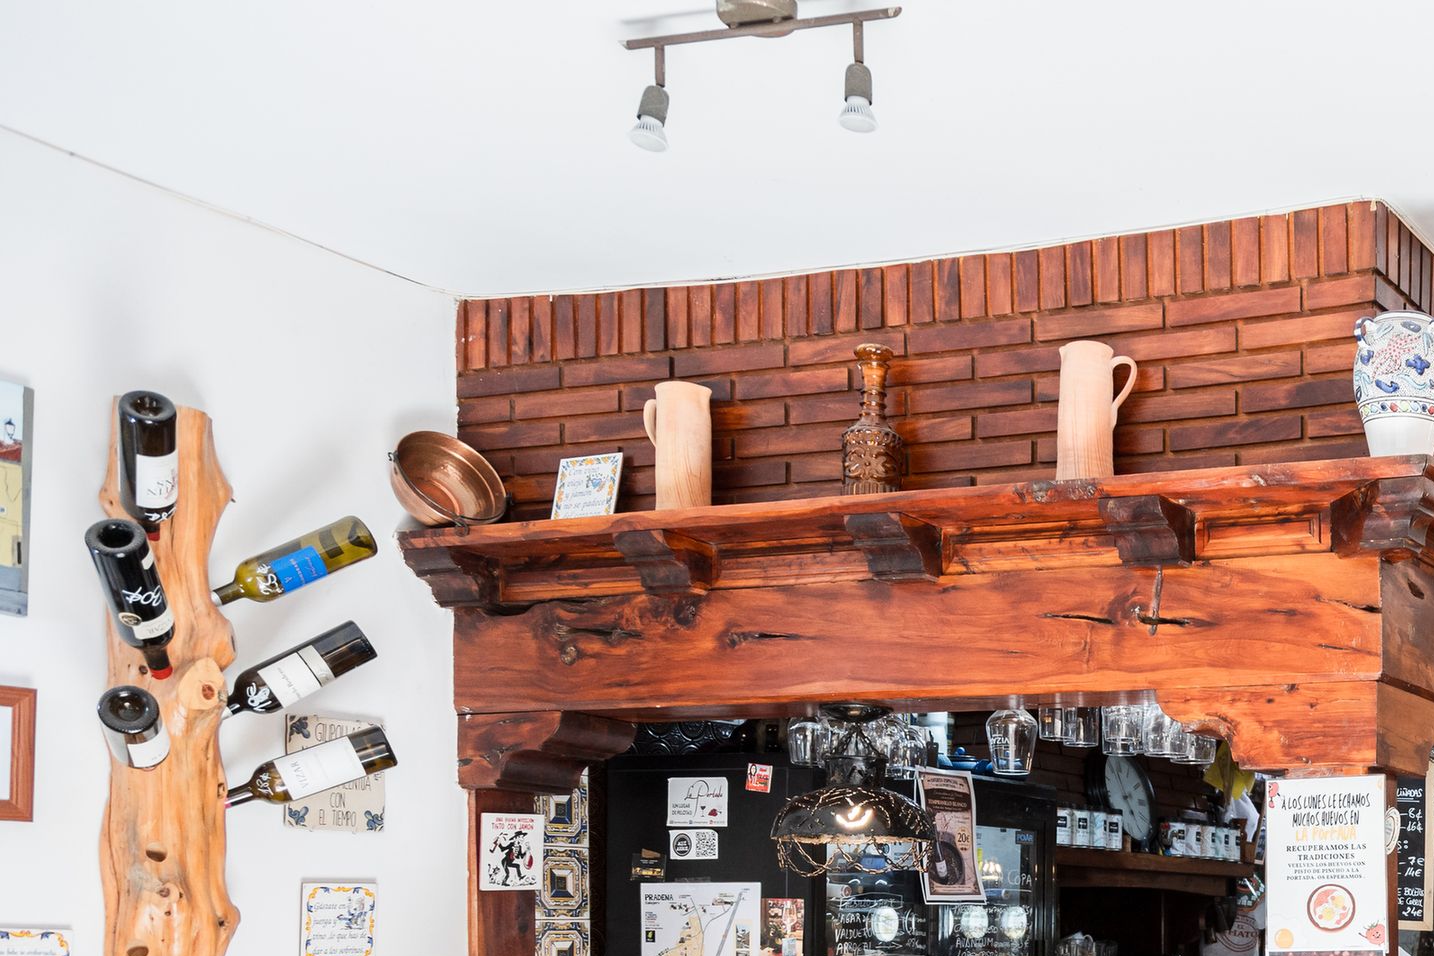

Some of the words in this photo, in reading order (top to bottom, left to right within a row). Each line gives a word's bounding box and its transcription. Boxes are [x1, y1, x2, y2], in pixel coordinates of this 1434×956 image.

[330, 792, 345, 808] CON
[1282, 796, 1287, 810] A
[1288, 795, 1301, 810] LOS
[1303, 794, 1326, 809] LUNES
[1328, 793, 1336, 808] LE
[1338, 792, 1371, 808] ECHAMOS
[332, 810, 357, 827] TIEMPO
[1292, 811, 1320, 827] MUCHOS
[1321, 810, 1348, 826] HUEVOS
[1350, 810, 1360, 825] EN
[1408, 807, 1423, 820] 8€
[957, 832, 970, 843] 20€
[1286, 844, 1349, 852] RECUPERAMOS
[1298, 853, 1355, 861] TRADICIONES
[1408, 856, 1424, 866] 7€
[1404, 868, 1422, 877] 14€
[1402, 907, 1422, 917] 24€
